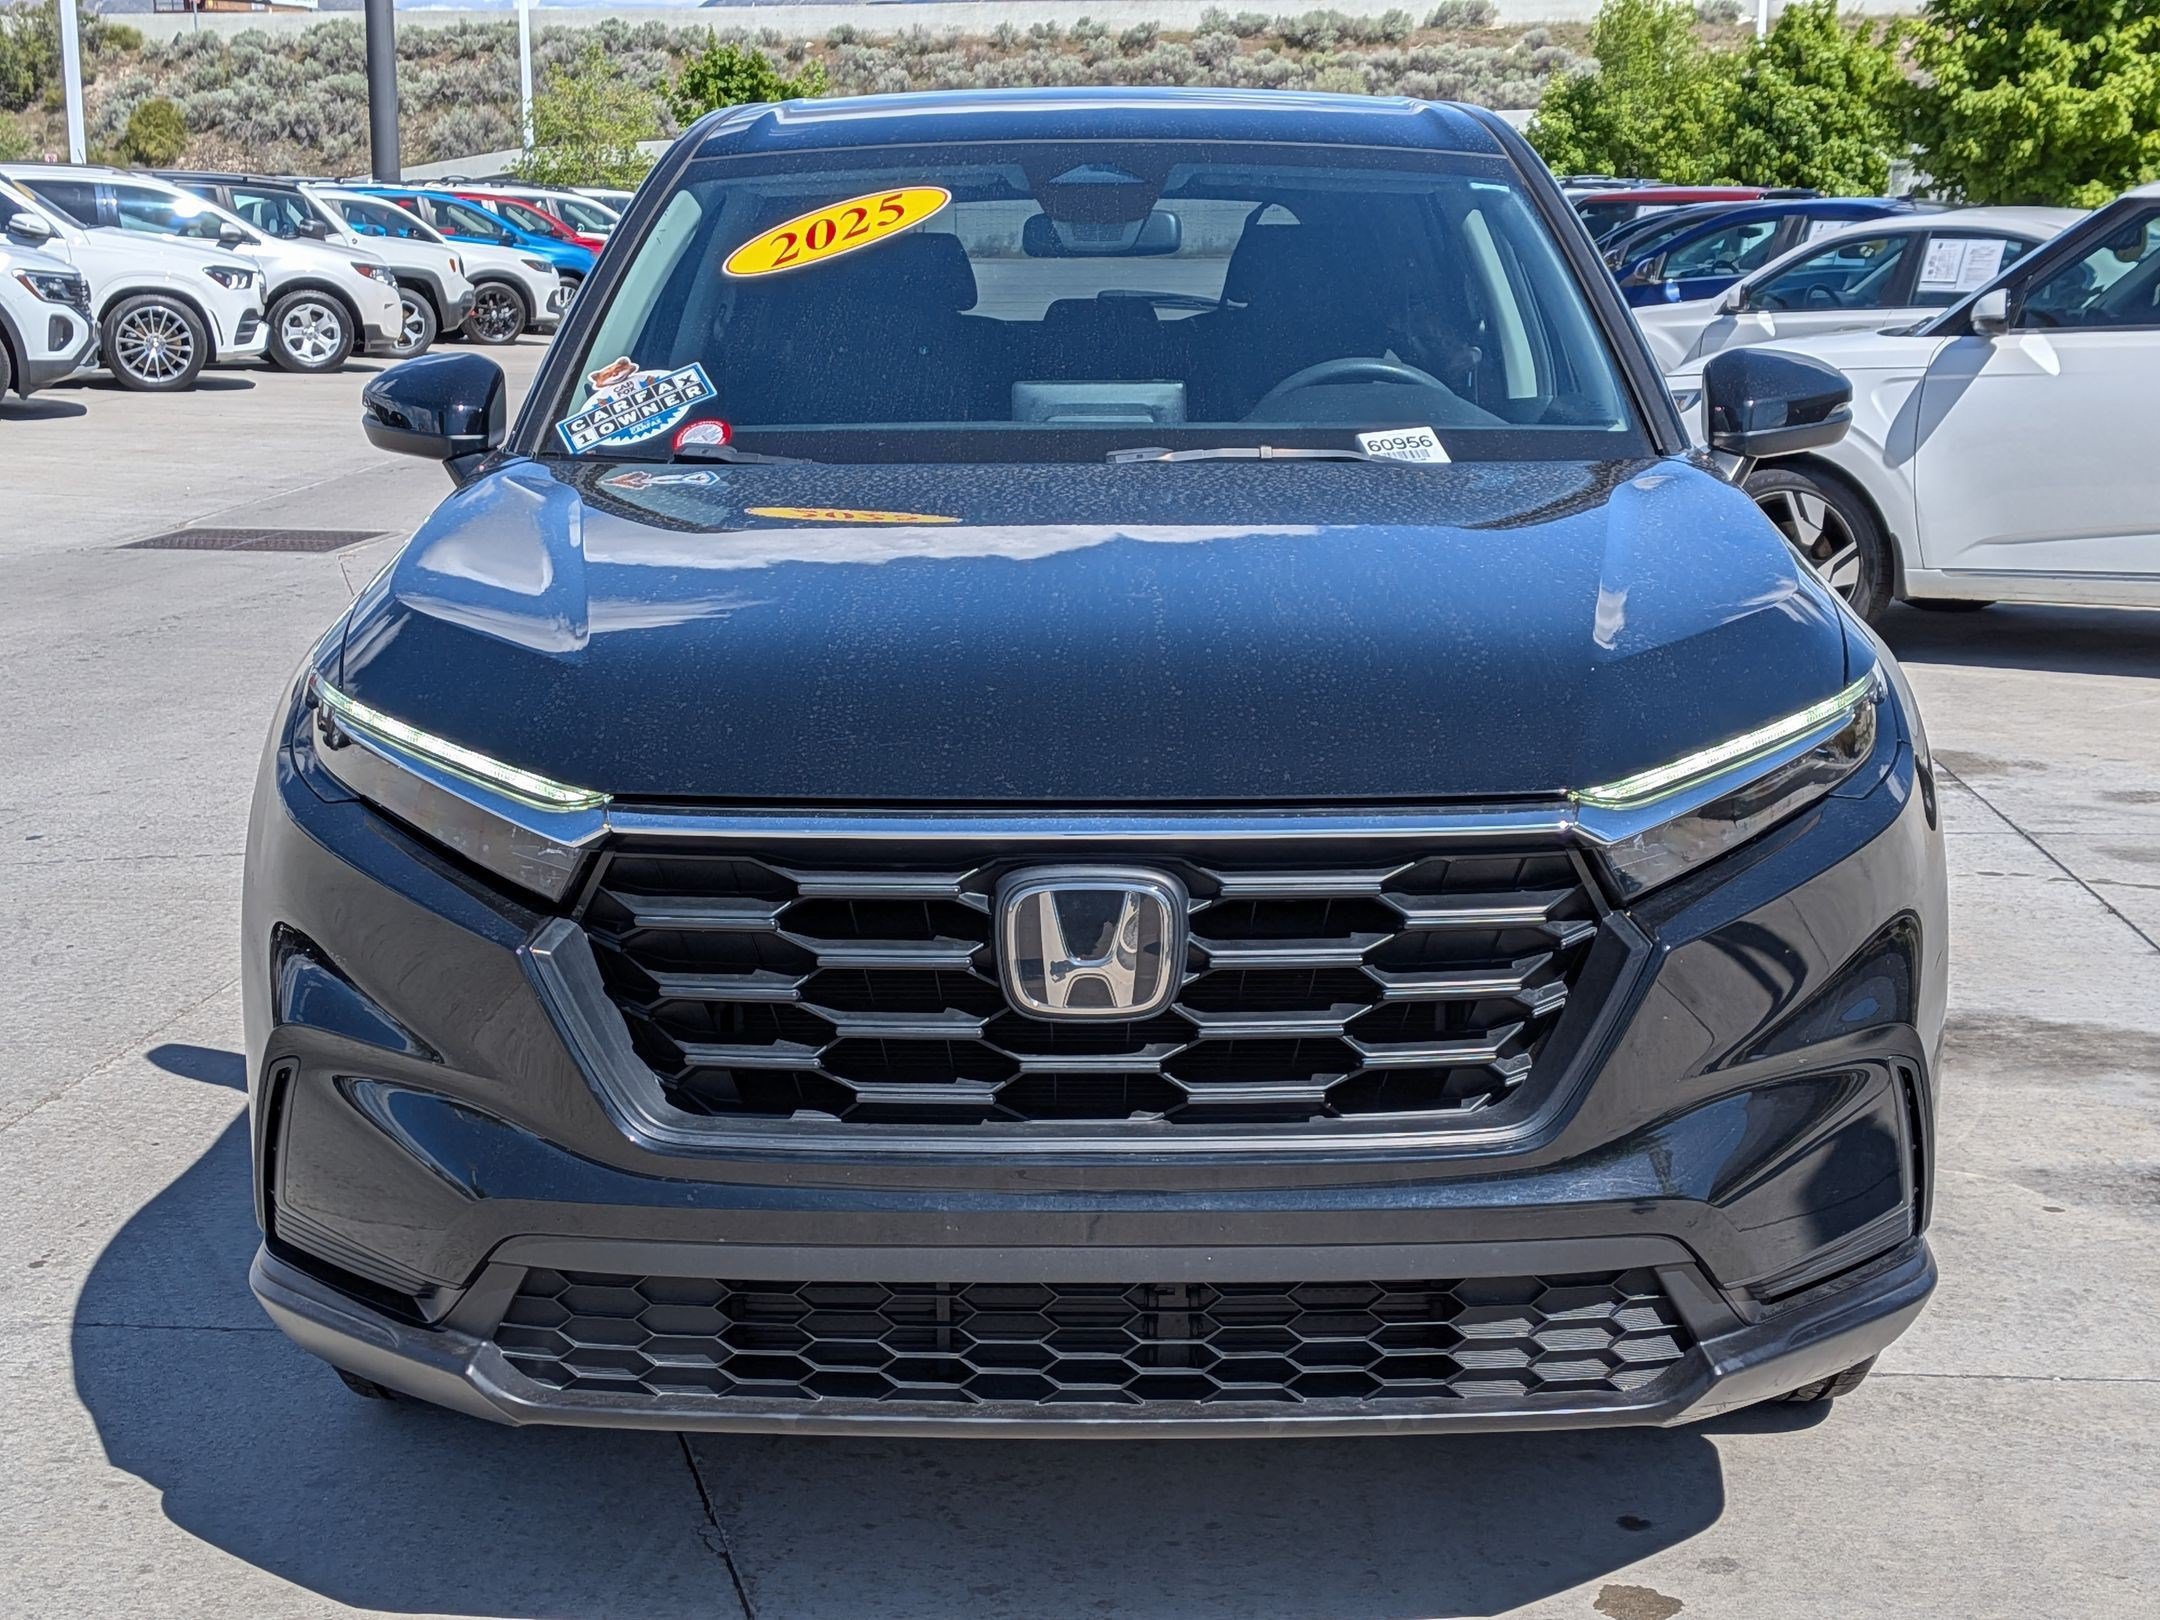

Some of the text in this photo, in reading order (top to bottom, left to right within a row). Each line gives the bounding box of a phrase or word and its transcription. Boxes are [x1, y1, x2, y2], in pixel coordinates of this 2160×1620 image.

[770, 193, 905, 267] 2025
[571, 374, 697, 432] CARFAX
[613, 380, 635, 393] CAR
[616, 386, 637, 398] FOX
[578, 432, 593, 445] 1
[598, 385, 703, 437] OWNER
[1367, 434, 1433, 452] 60956
